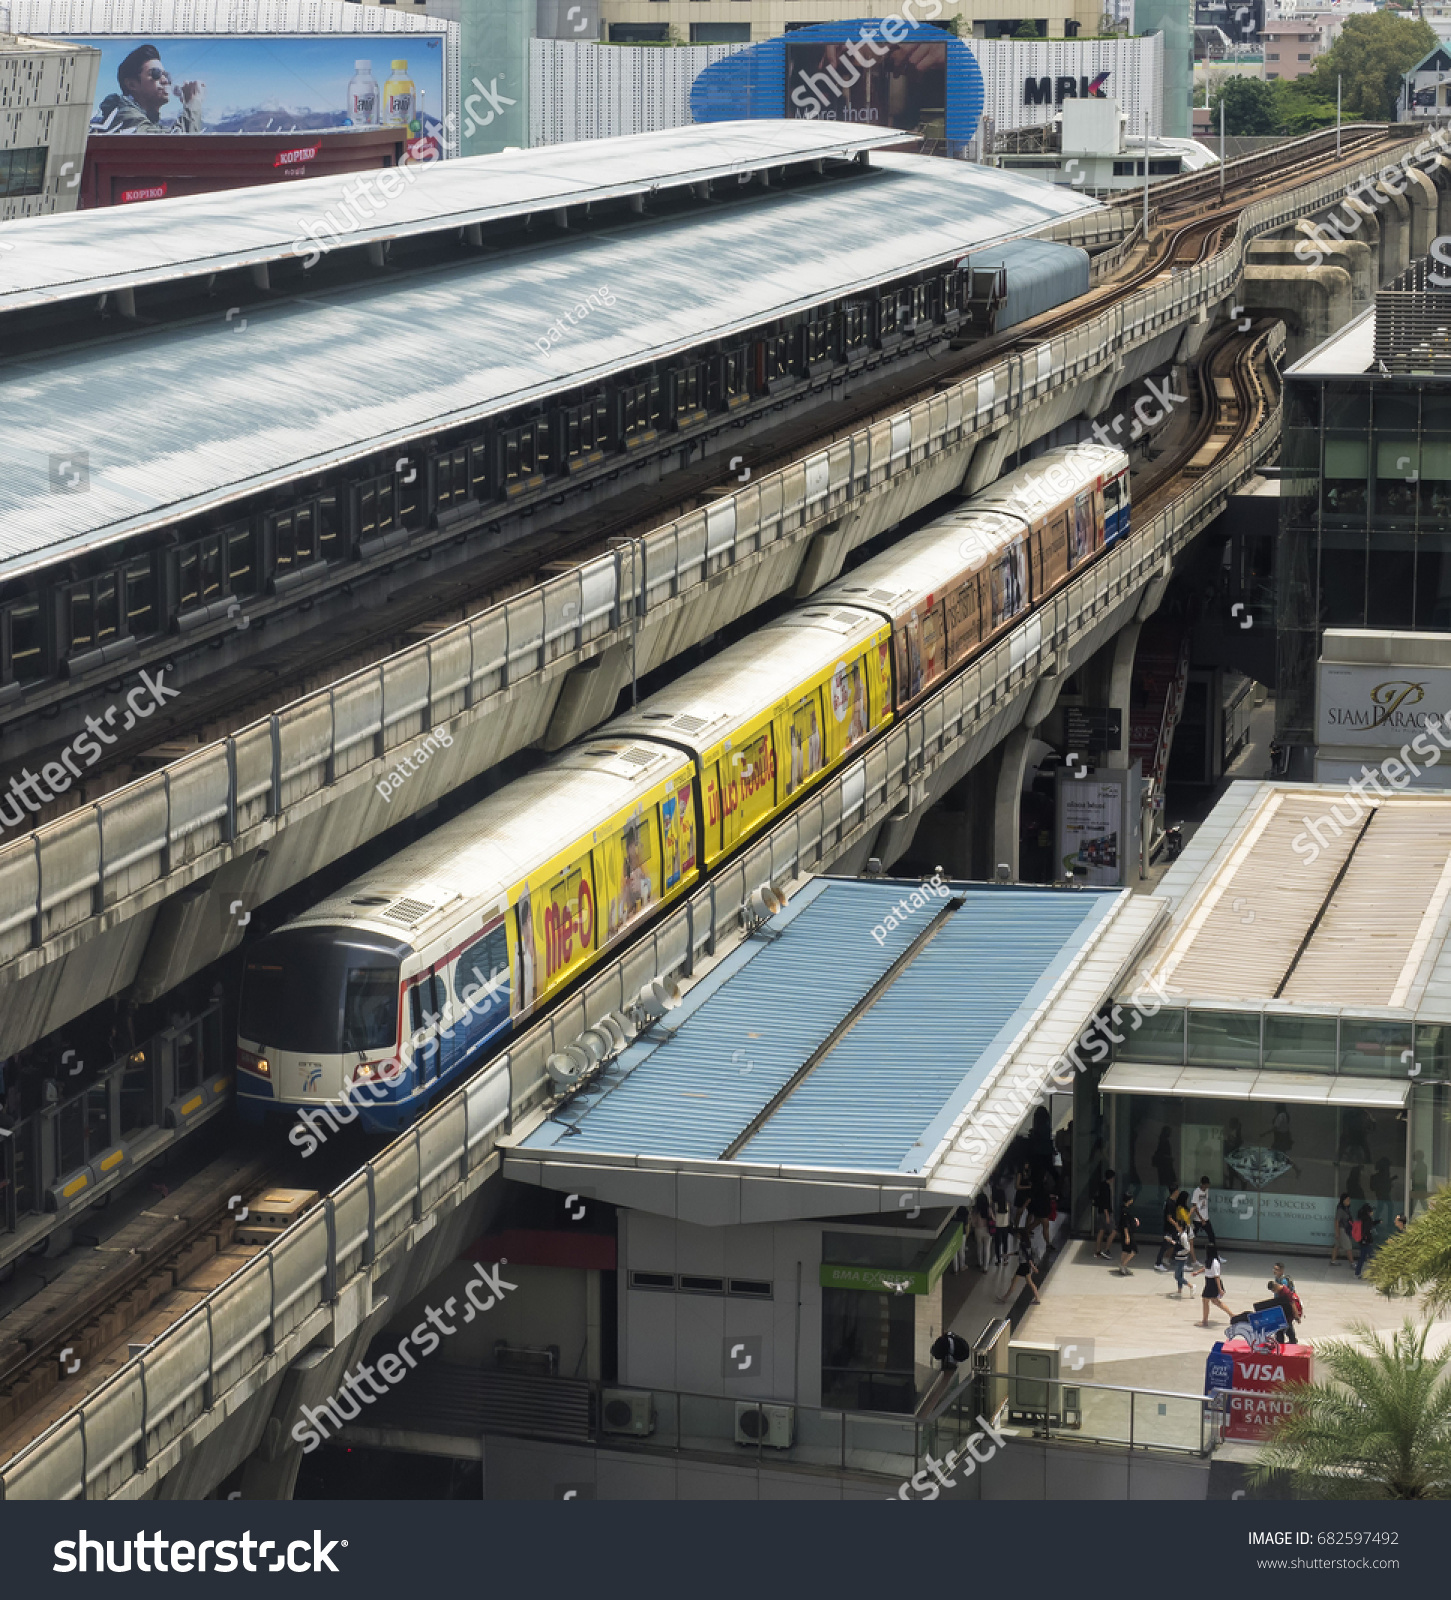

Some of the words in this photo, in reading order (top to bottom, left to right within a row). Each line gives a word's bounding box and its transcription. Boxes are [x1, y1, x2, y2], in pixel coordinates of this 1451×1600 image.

[1024, 72, 1111, 105] MBK
[842, 101, 879, 121] than
[280, 148, 315, 164] KOPIKO
[125, 188, 163, 201] KOPIKO
[1327, 707, 1369, 725] SIAM
[832, 1269, 860, 1281] BMA
[1237, 1362, 1285, 1382] VISA
[1231, 1397, 1294, 1414] GRAND
